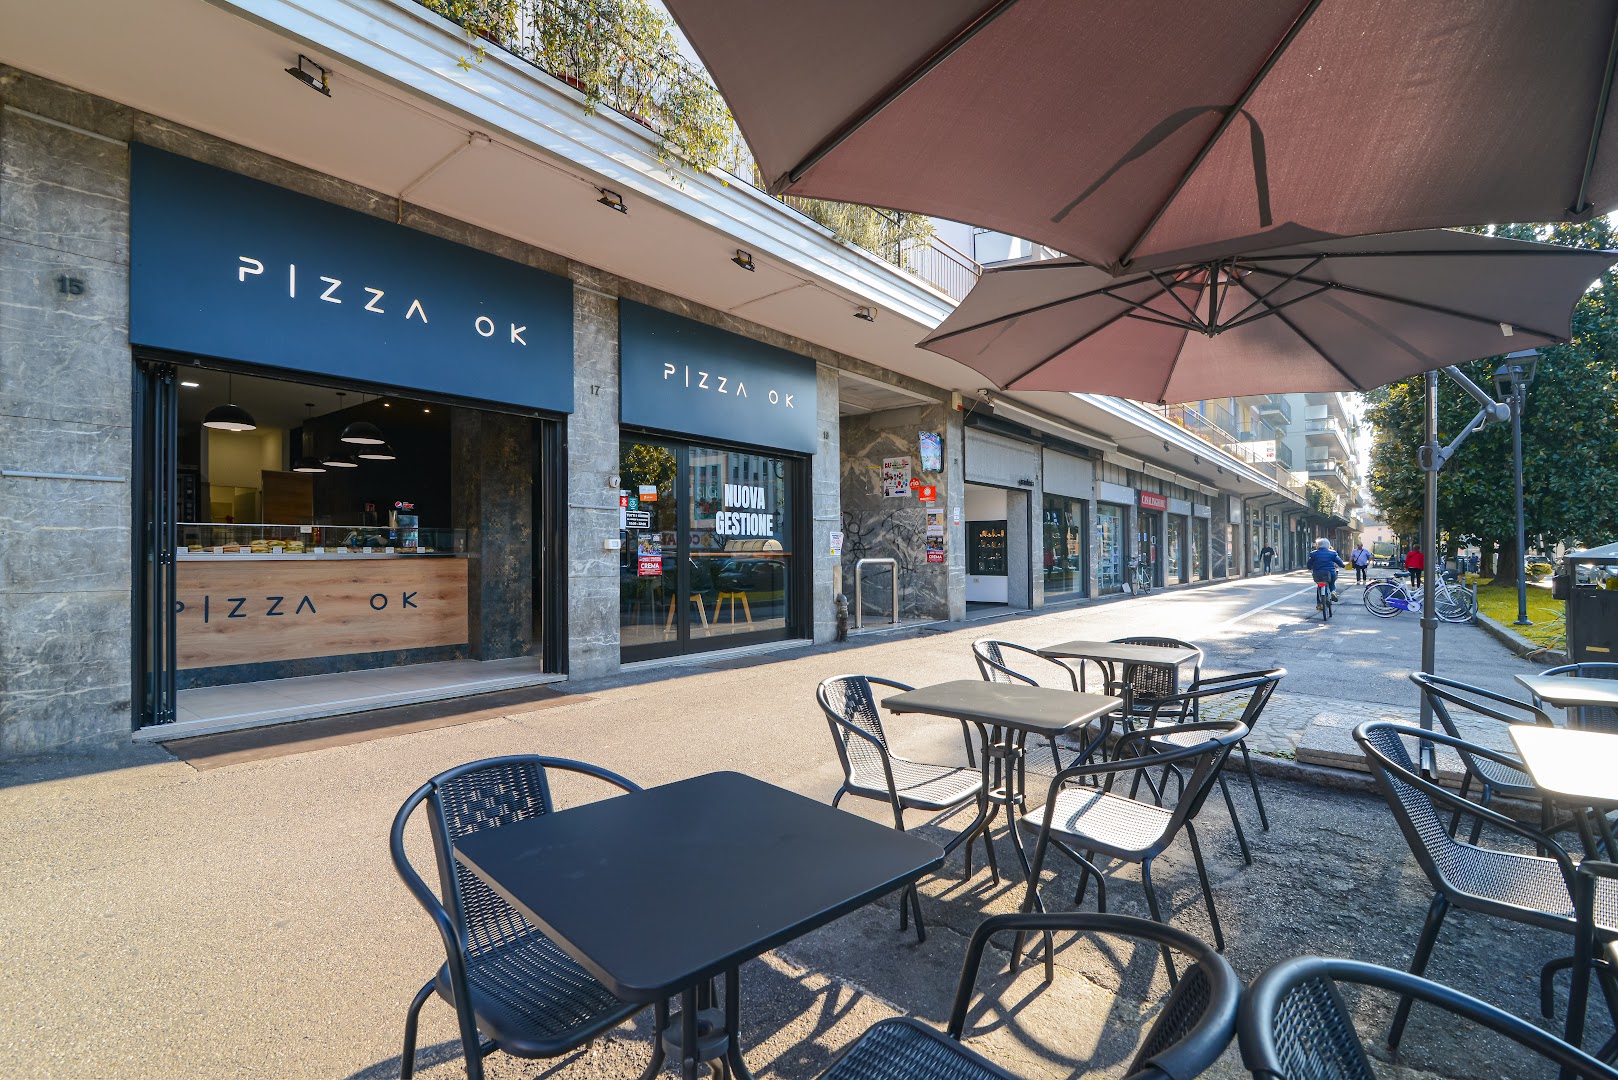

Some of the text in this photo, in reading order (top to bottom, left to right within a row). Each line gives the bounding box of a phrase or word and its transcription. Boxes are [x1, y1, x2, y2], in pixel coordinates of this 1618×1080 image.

[57, 274, 84, 295] 15
[239, 256, 527, 346] PIZZA OK
[590, 384, 600, 396] 17
[664, 362, 794, 409] PIZZA OK
[724, 484, 765, 509] NUOVA
[715, 511, 774, 536] GESTIONE
[640, 562, 660, 570] CREMA
[370, 592, 417, 610] OK
